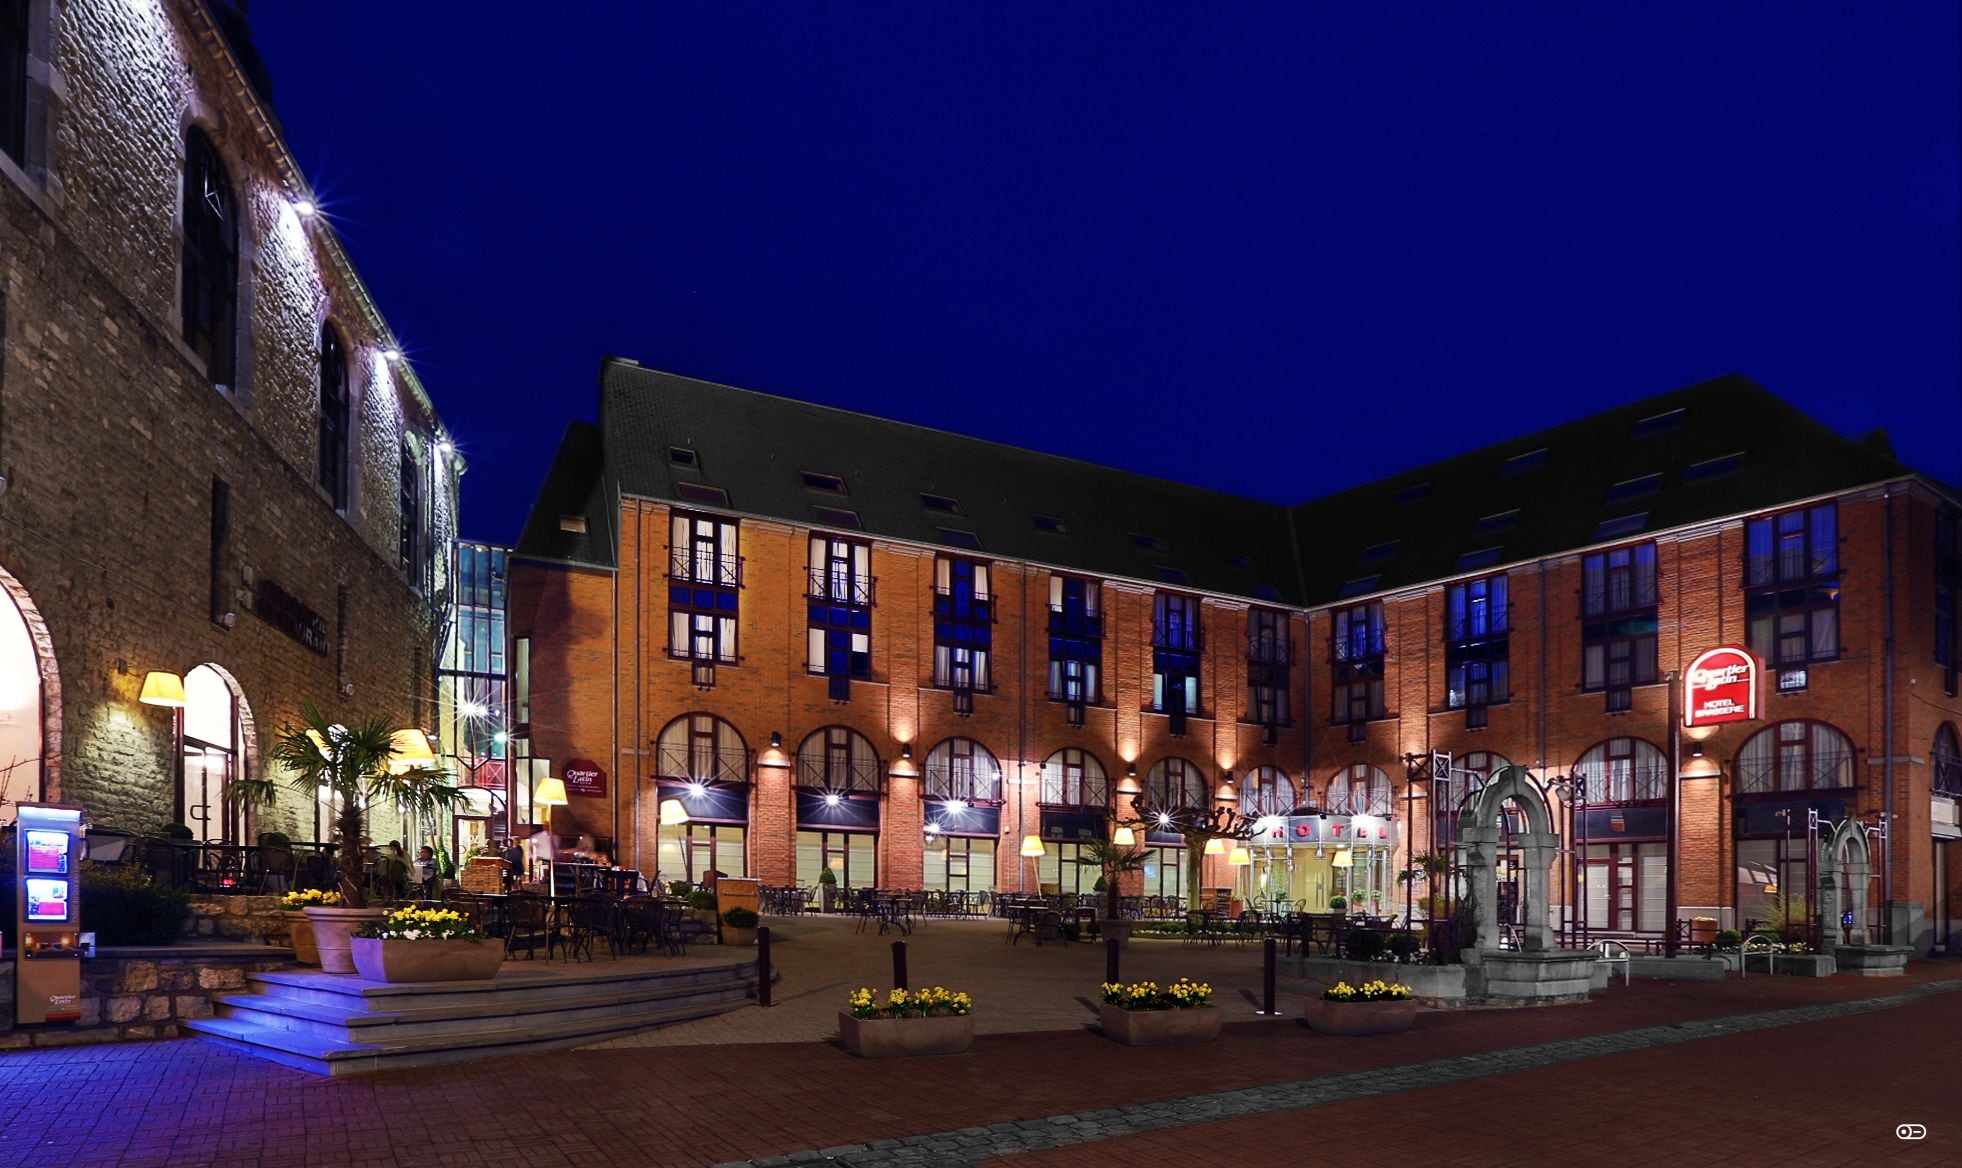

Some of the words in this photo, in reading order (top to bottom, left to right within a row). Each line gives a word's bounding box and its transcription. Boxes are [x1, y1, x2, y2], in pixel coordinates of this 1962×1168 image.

[1703, 698, 1736, 709] HOTEL
[566, 769, 599, 780] Quartier
[572, 775, 593, 784] Latin
[1271, 822, 1388, 839] HOTEL
